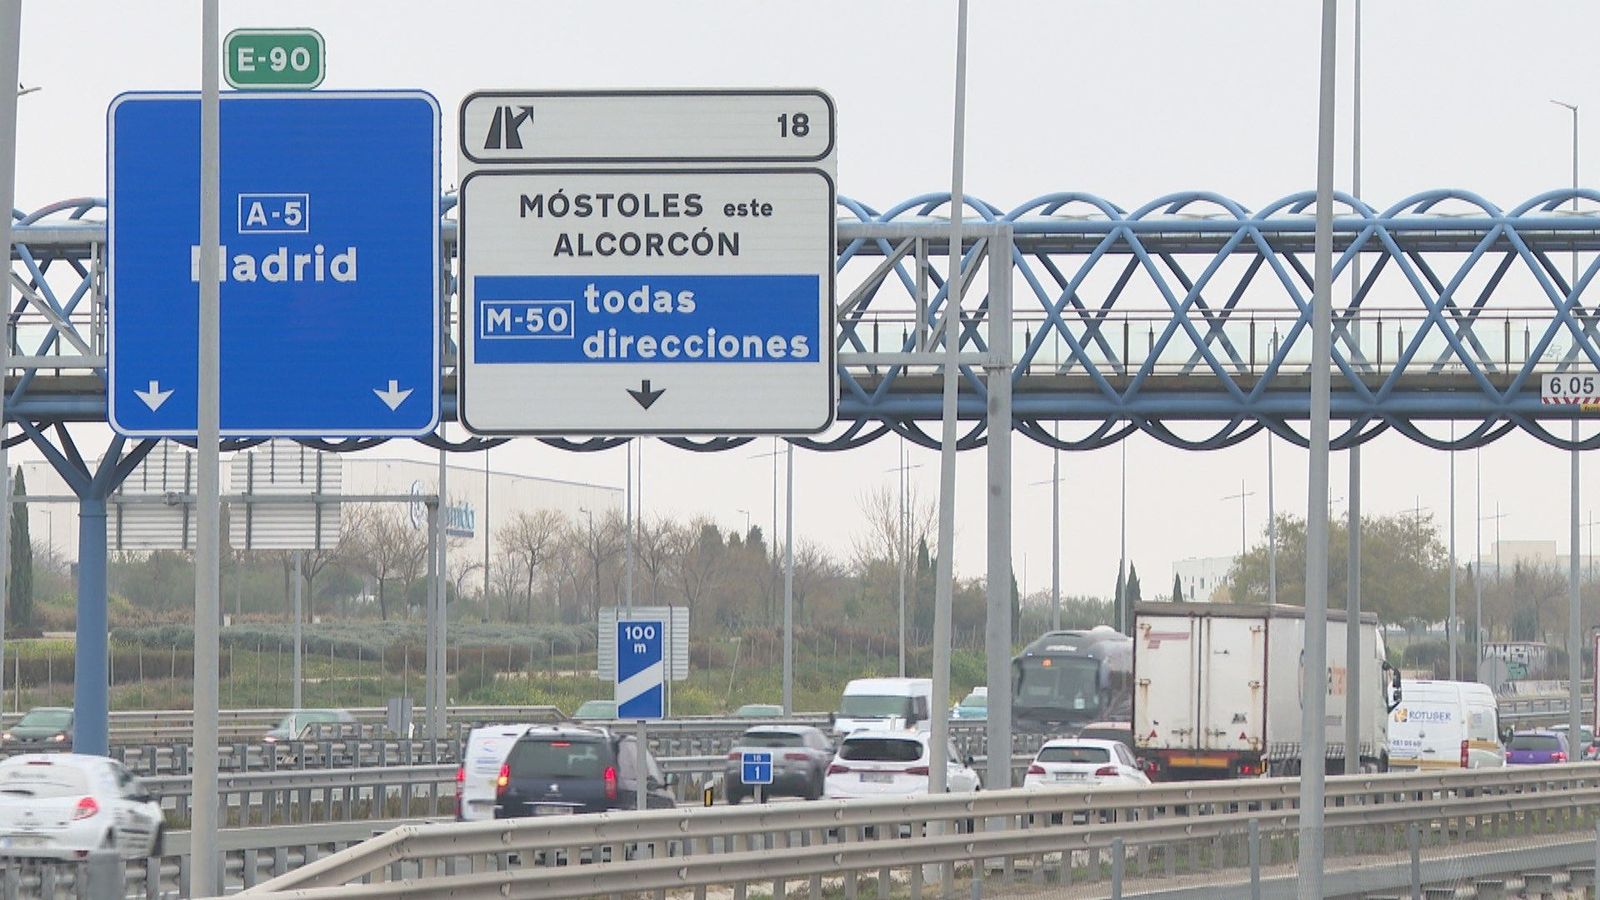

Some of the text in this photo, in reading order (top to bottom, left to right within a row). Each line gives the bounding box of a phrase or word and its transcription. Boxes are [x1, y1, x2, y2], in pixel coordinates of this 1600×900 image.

[237, 46, 311, 72] E-90
[777, 113, 810, 138] 18
[246, 201, 303, 226] A-5
[519, 188, 774, 218] MÓSTOLES este
[552, 227, 740, 257] ALCORCÓN
[583, 283, 697, 314] todas
[486, 307, 569, 333] M-50
[582, 327, 811, 359] direcciones
[1549, 376, 1595, 398] 6,05
[624, 625, 656, 640] 100
[633, 642, 647, 654] m
[755, 765, 760, 780] 1
